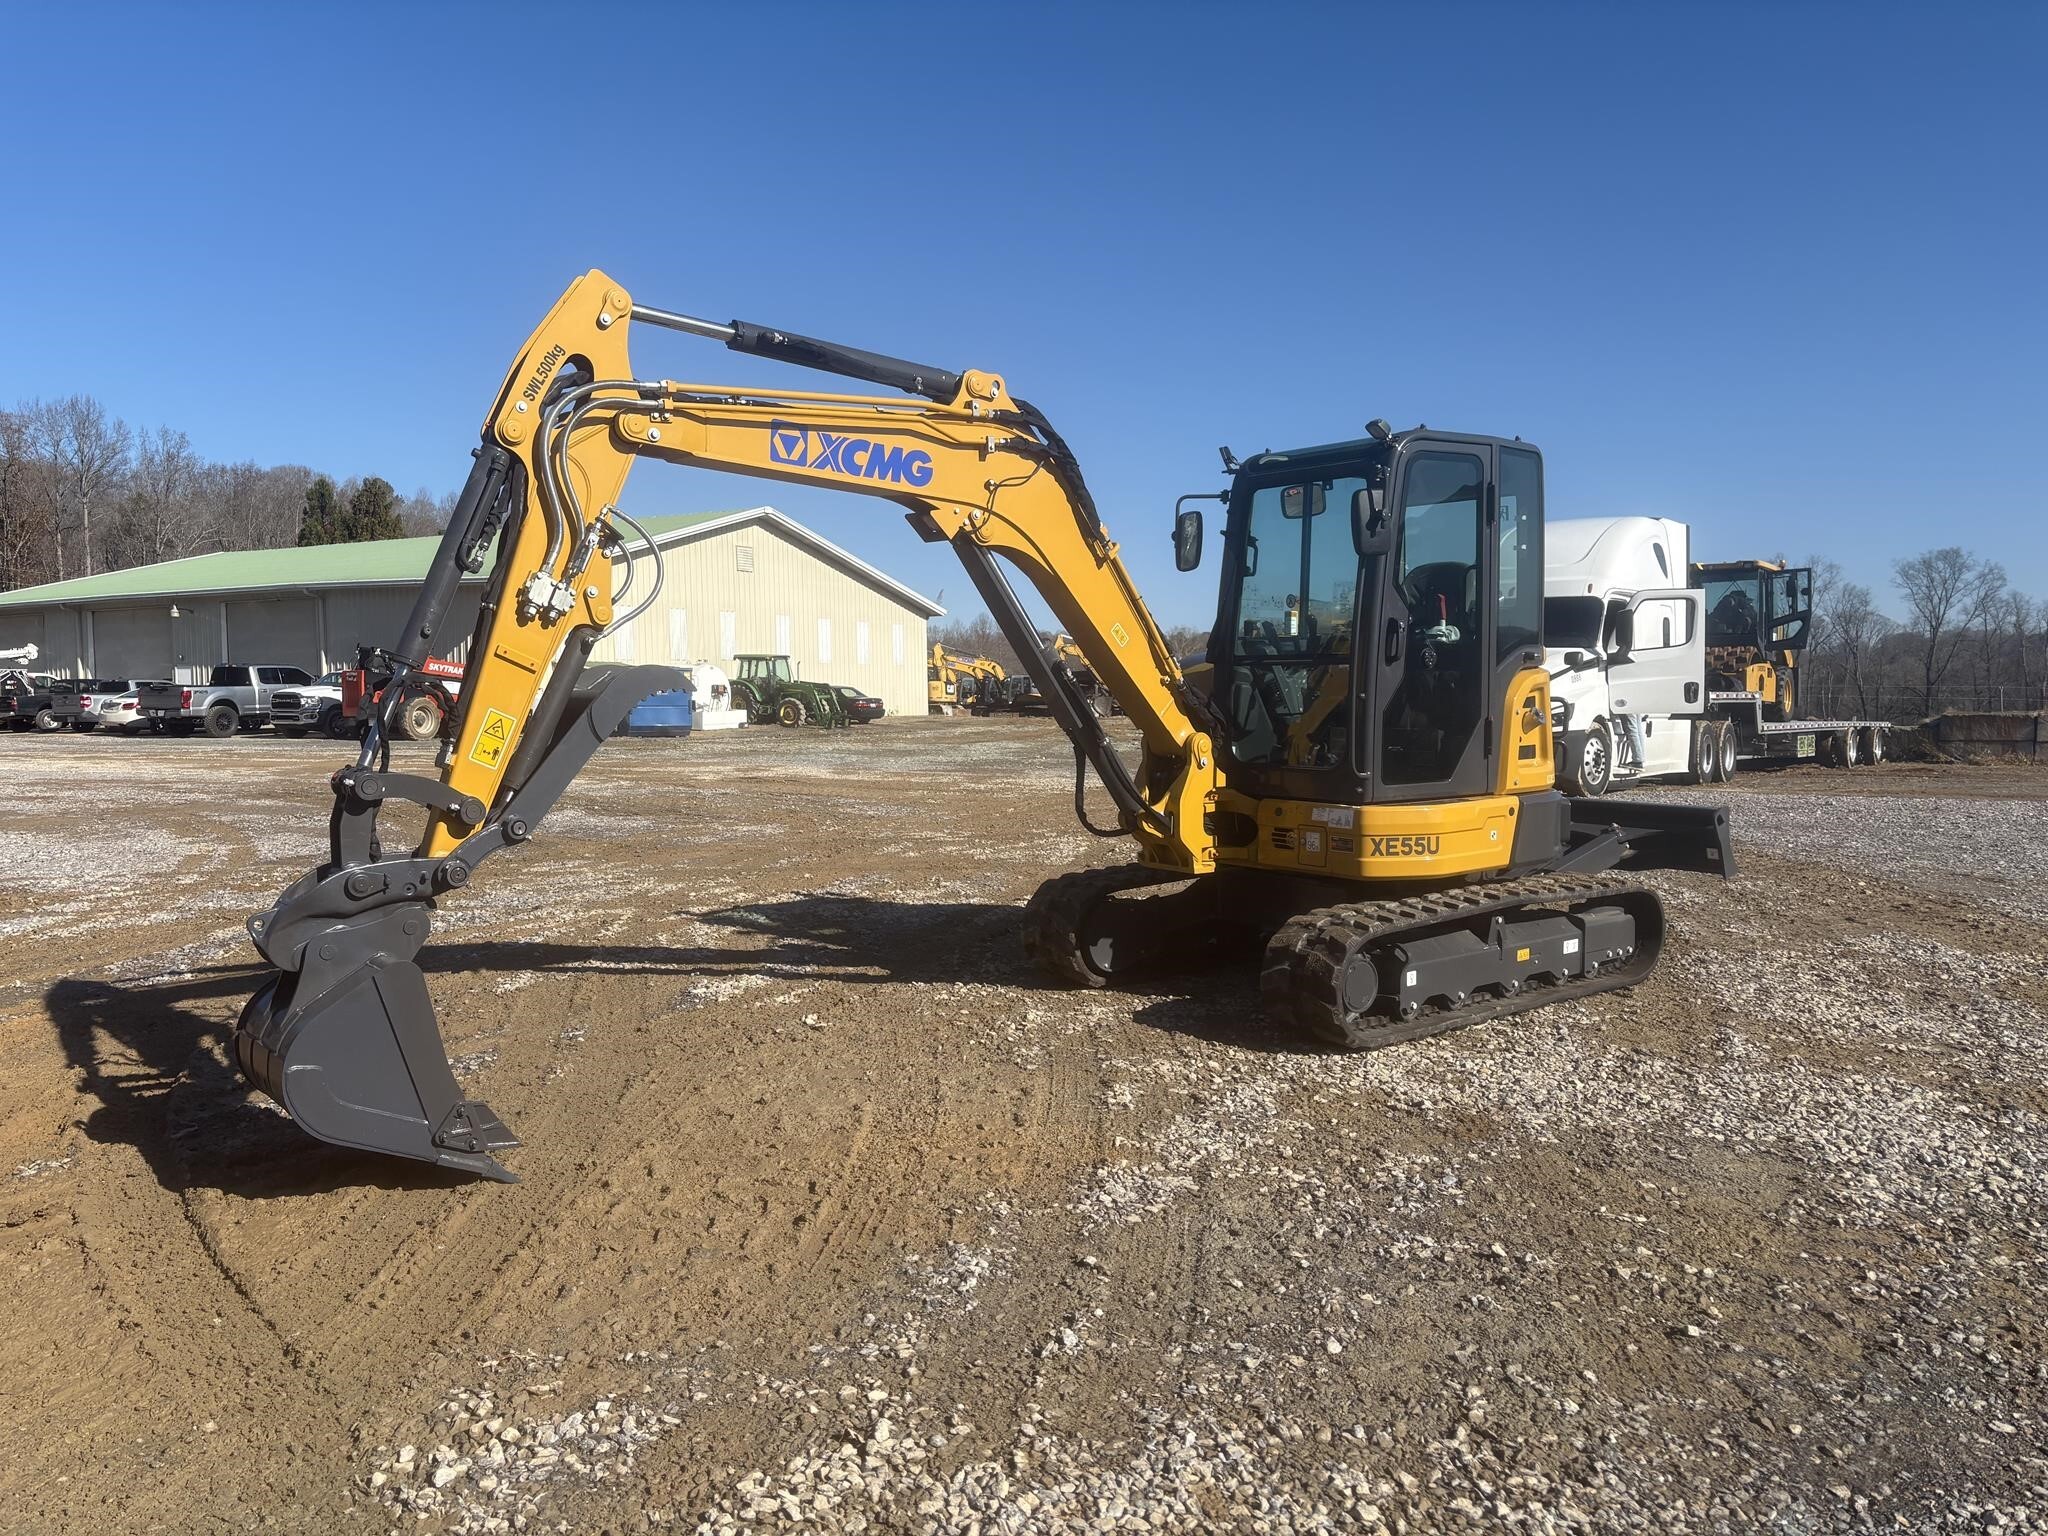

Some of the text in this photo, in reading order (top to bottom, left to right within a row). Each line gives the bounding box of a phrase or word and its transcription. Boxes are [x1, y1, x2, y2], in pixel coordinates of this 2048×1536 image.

[523, 344, 566, 401] SWL500kg
[809, 431, 934, 488] XCMG
[428, 662, 464, 675] SKYTRAK
[1370, 836, 1440, 856] XE55U
